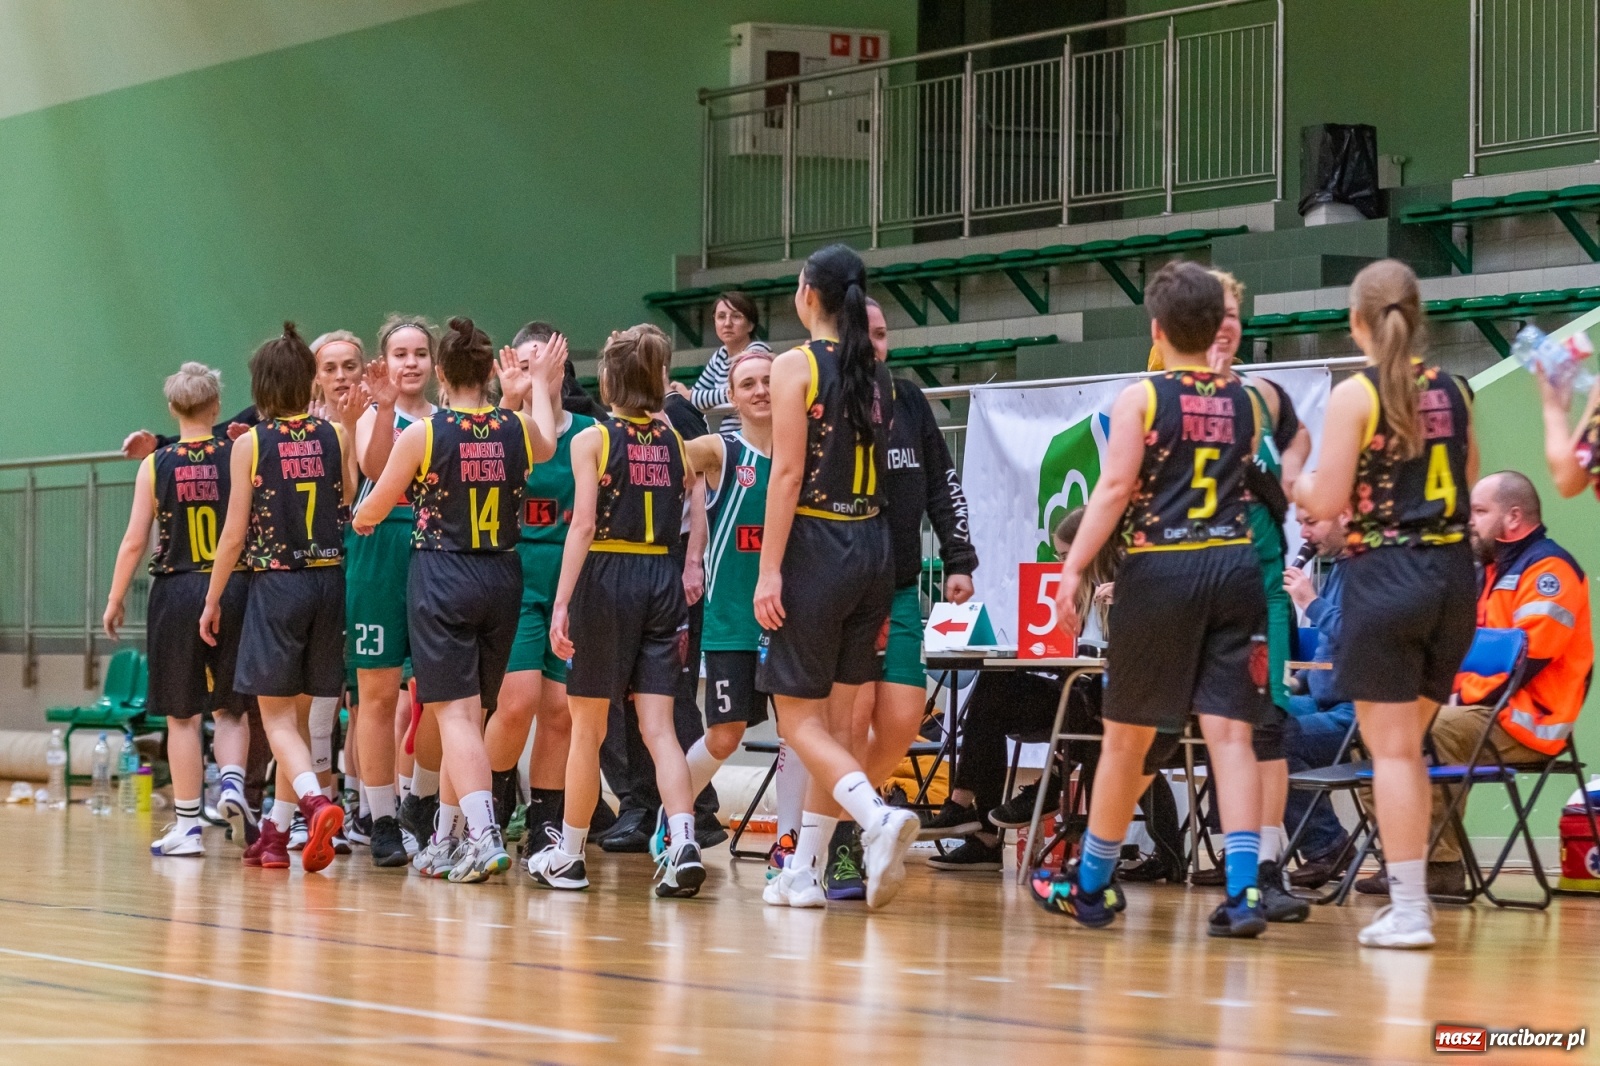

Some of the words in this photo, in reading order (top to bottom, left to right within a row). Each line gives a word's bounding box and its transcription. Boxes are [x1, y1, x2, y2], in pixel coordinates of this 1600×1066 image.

[280, 457, 325, 480] POLSKA
[459, 442, 505, 459] KAMIENICA
[460, 459, 506, 482] POLSKA
[176, 481, 219, 502] POLSKA
[629, 463, 671, 487] POLSKA
[1187, 447, 1221, 519] 5
[1425, 443, 1457, 518] 4
[296, 482, 317, 540] 7
[469, 486, 500, 549] 14
[644, 491, 655, 543] 1
[186, 505, 217, 563] 10
[1027, 572, 1062, 636] 5
[355, 623, 385, 656] 23
[715, 679, 732, 713] 5
